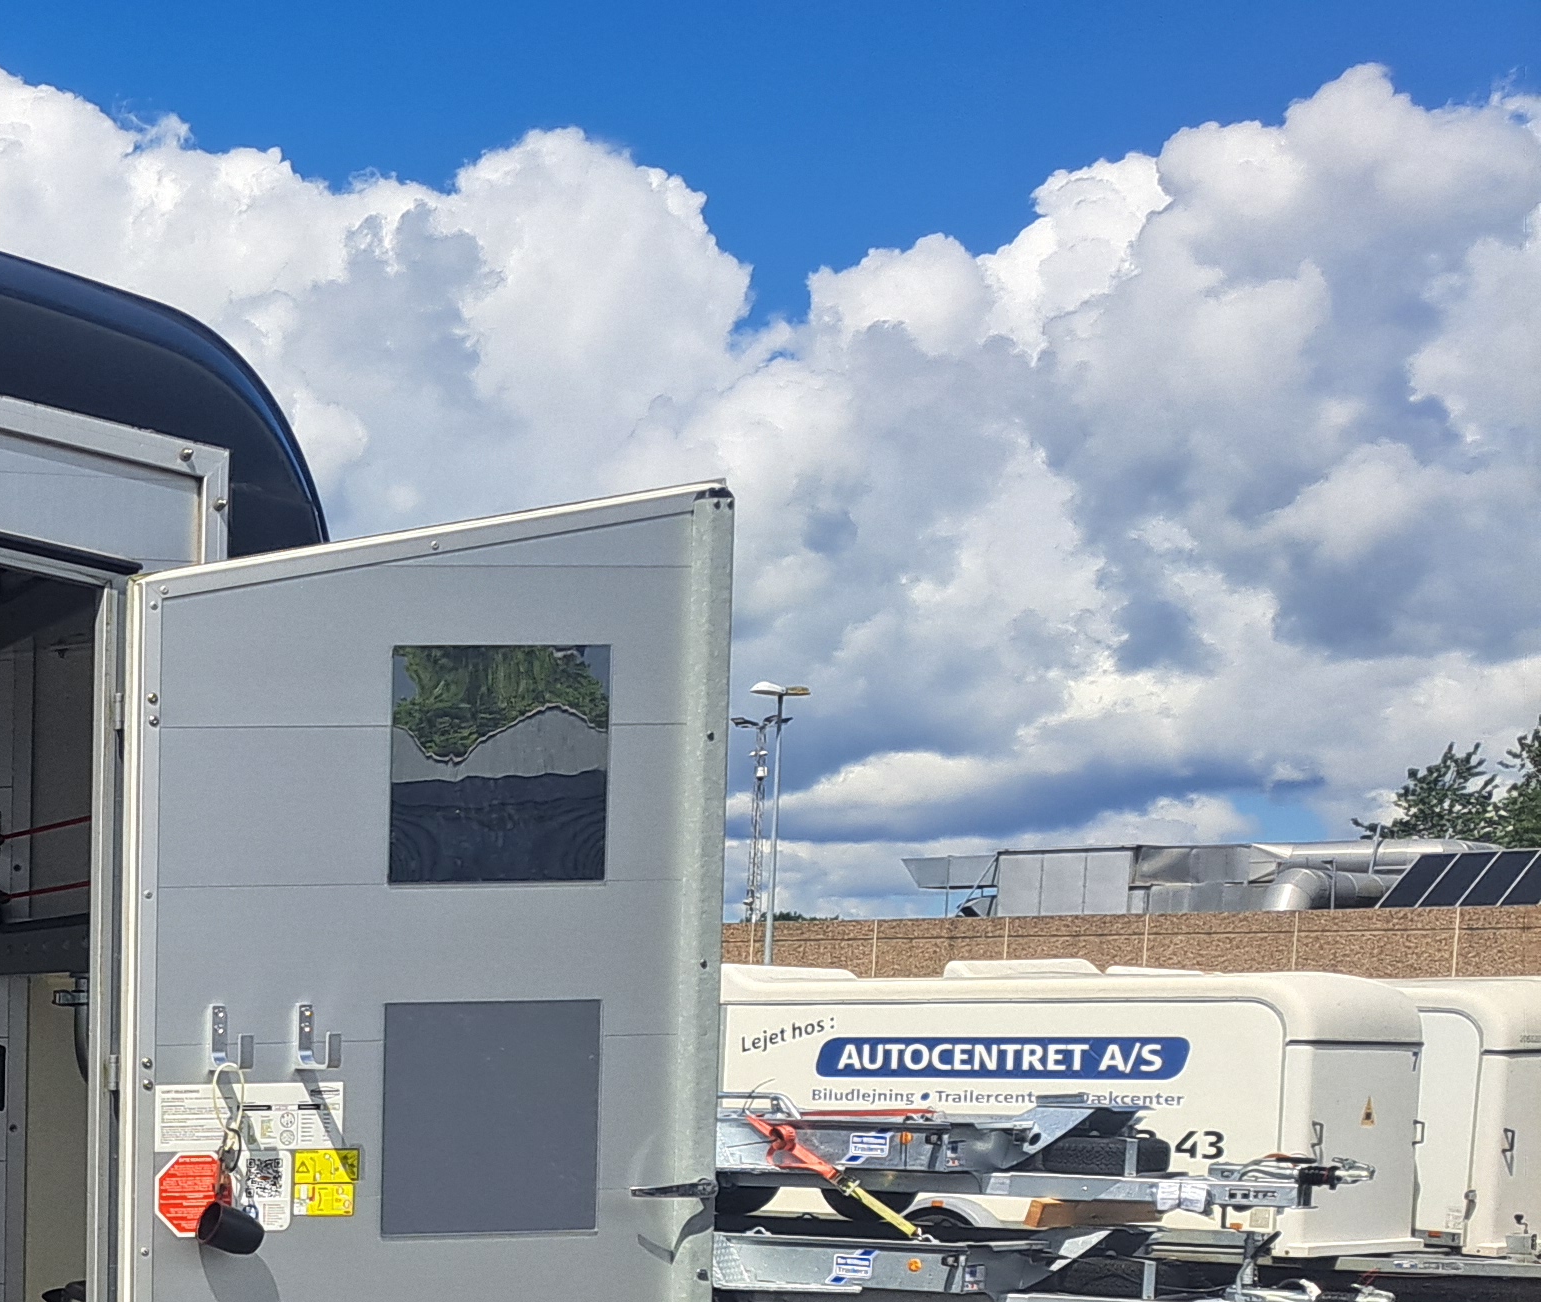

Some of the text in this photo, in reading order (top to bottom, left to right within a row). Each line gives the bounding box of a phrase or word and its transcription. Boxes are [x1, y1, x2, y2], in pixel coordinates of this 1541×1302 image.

[741, 1026, 786, 1053] Lejet
[836, 1042, 1164, 1074] AUTOCENTRET A/S
[811, 1088, 916, 1106] Biludlejning
[935, 1089, 1036, 1104] Trailercent
[1173, 1130, 1225, 1160] 43
